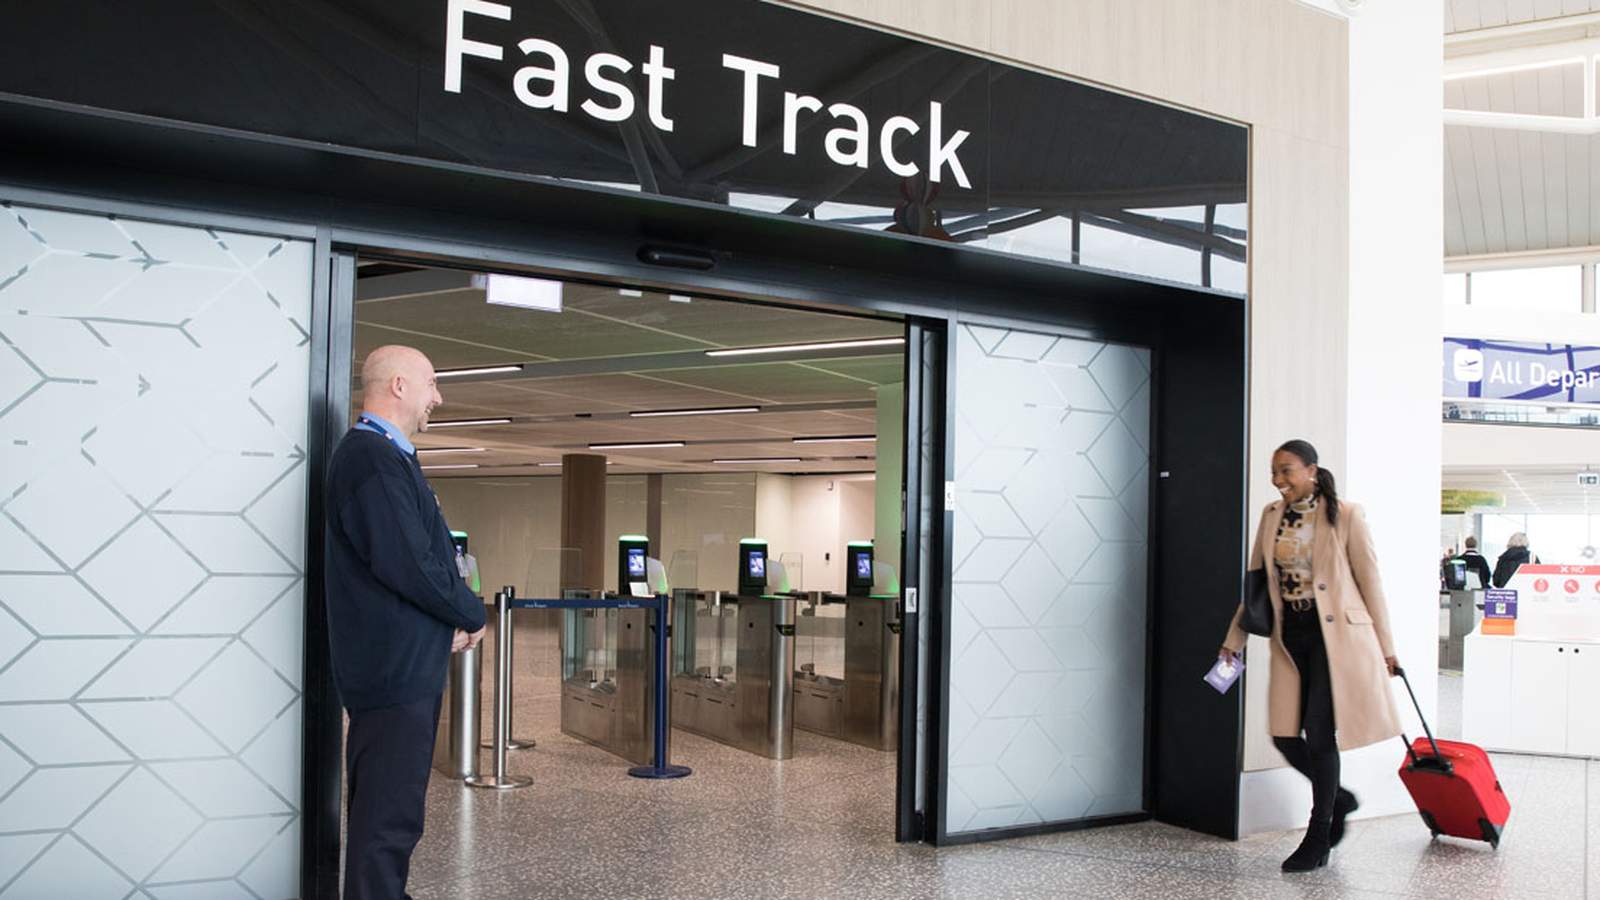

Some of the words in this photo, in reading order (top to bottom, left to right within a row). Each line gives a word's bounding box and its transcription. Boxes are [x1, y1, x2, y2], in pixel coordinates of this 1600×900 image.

[444, 0, 675, 132] Fast
[722, 53, 972, 190] Track
[1490, 360, 1522, 385] All
[1530, 361, 1600, 393] Depar
